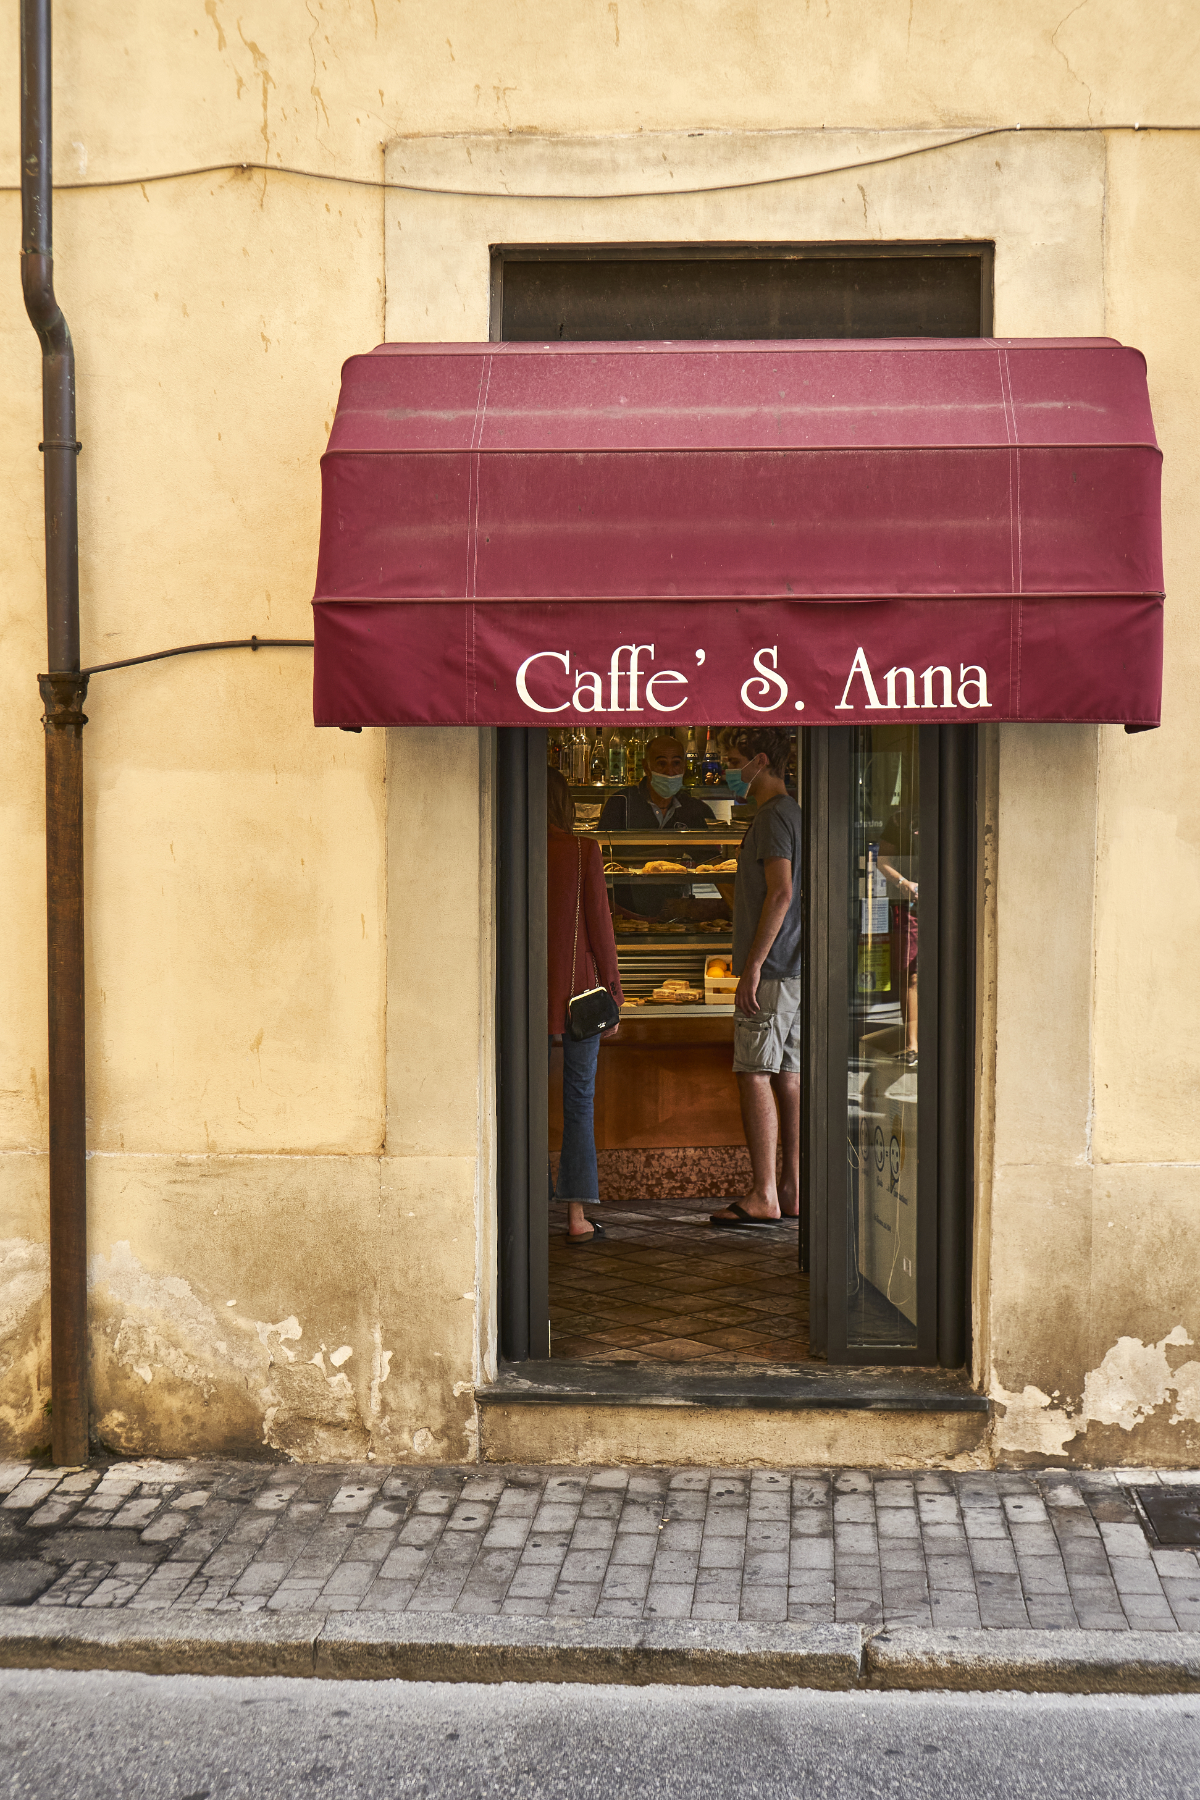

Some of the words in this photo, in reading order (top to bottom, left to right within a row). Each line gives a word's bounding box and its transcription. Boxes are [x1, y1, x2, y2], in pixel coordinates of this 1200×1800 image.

[515, 644, 706, 713] Caffe'
[740, 646, 805, 712] S.
[834, 647, 993, 710] Anna
